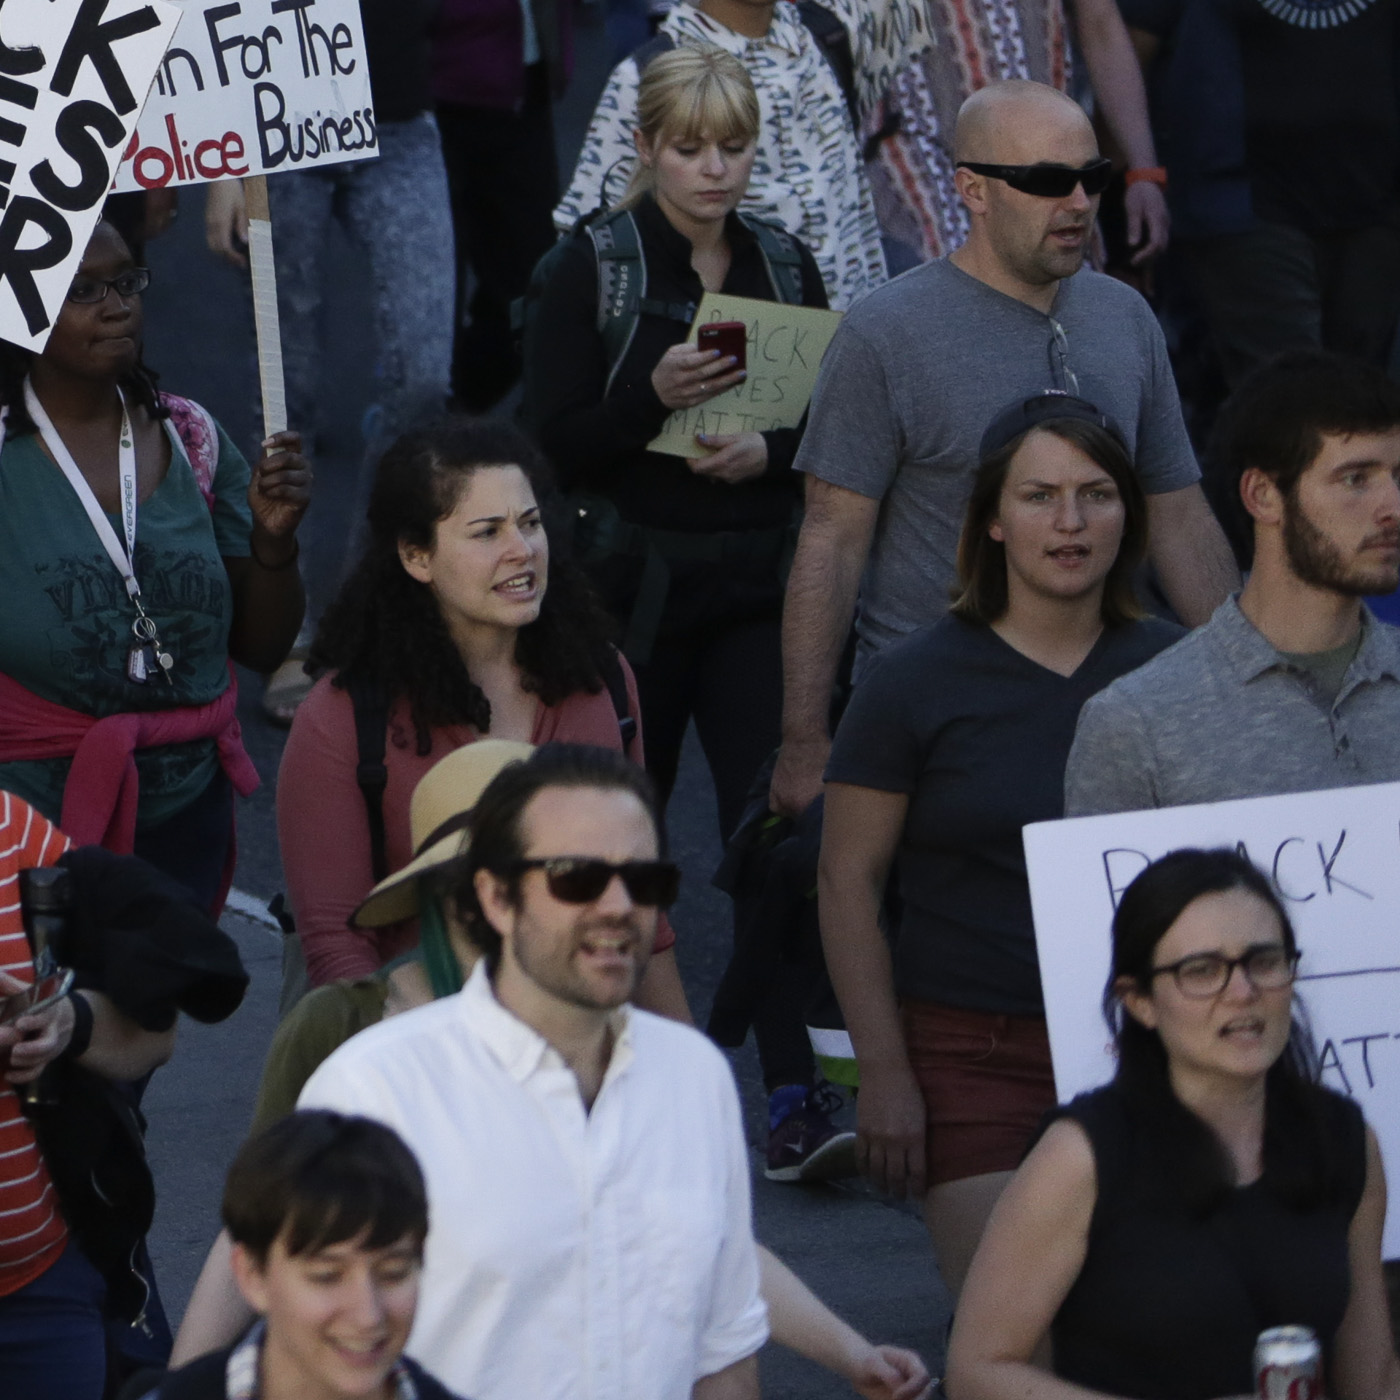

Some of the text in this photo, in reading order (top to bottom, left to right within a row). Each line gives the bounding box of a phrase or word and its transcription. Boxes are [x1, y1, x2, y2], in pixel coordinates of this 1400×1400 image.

[203, 1, 283, 87] For
[253, 80, 377, 169] Business
[125, 474, 134, 543] EVERGREEN
[46, 568, 227, 619] VINAGE
